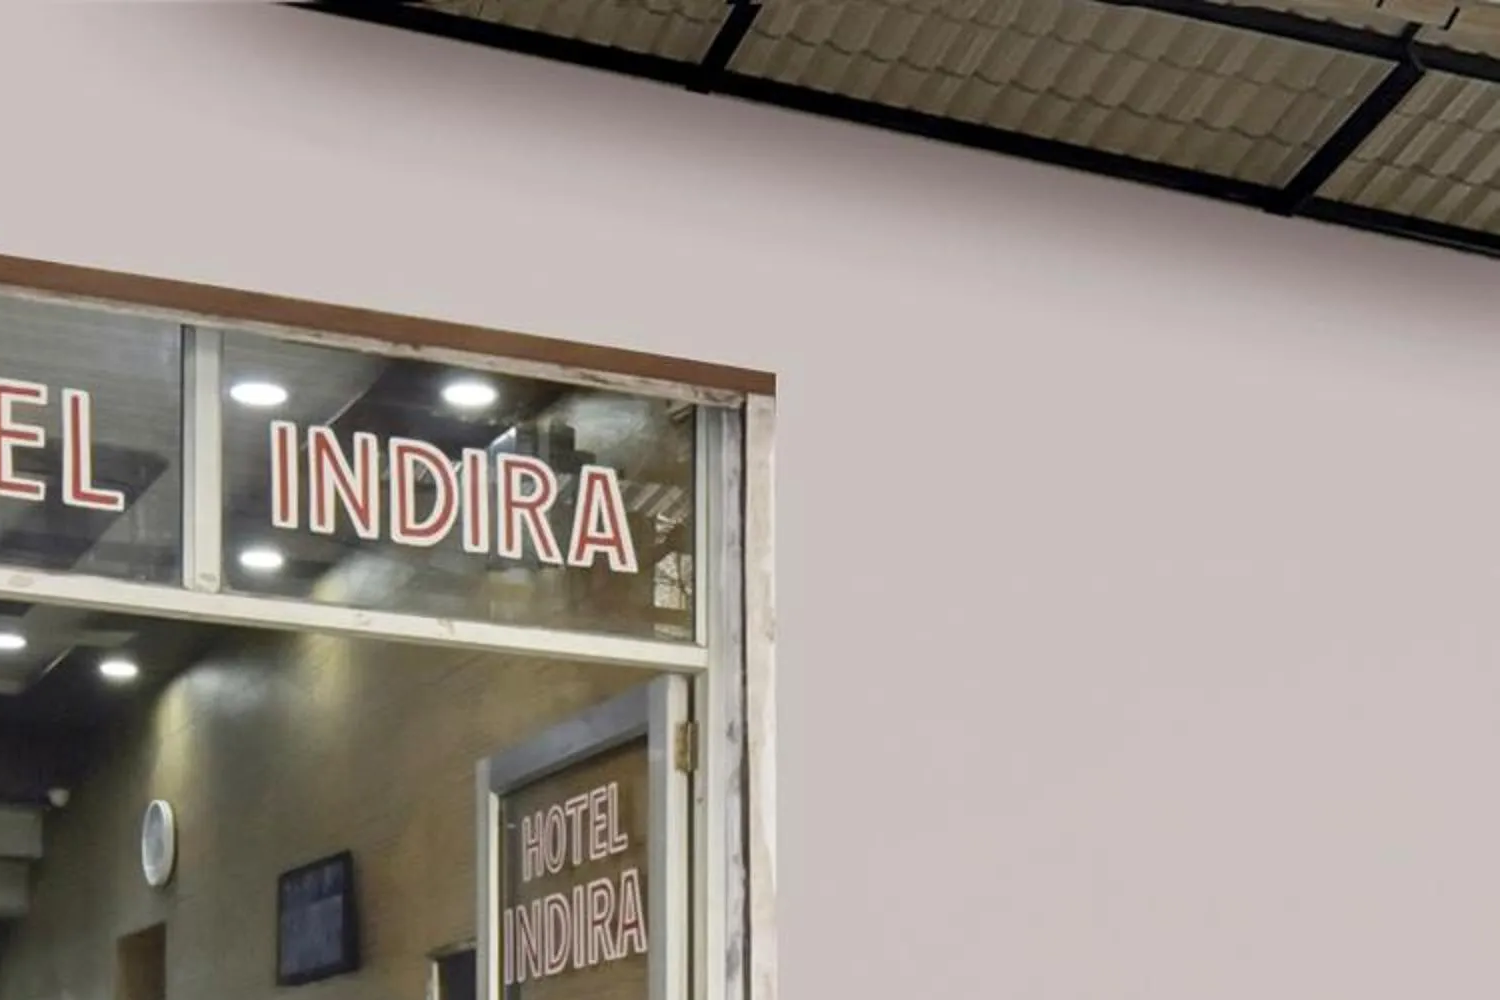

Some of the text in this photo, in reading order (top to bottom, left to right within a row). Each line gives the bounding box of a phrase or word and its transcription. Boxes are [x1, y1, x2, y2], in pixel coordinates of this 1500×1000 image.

[271, 421, 638, 573] INDIRA
[522, 783, 628, 882] HOTEL
[504, 869, 647, 985] INDIRA
